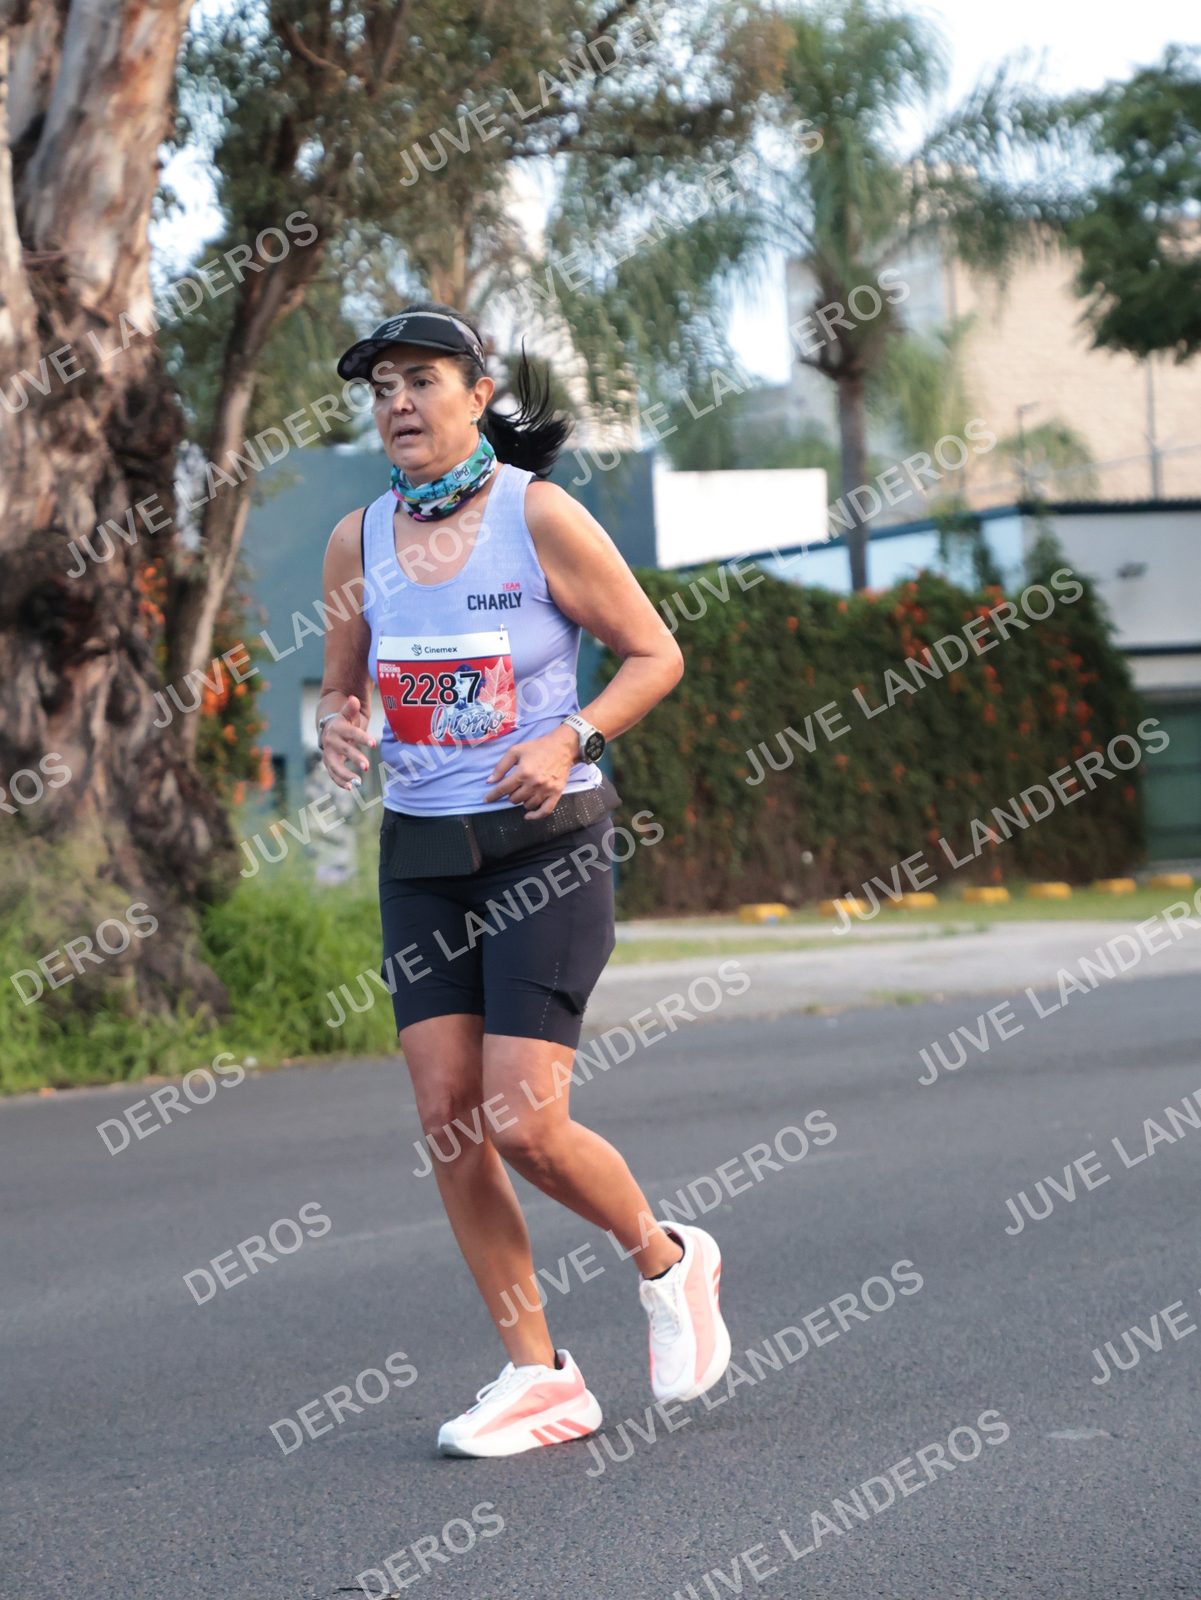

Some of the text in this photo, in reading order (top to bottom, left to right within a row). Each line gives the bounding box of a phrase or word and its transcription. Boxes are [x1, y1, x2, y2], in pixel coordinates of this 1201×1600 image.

[502, 582, 521, 591] TEAM
[467, 592, 522, 610] CHARLY
[424, 645, 458, 655] Cinemex
[400, 671, 482, 707] 2287
